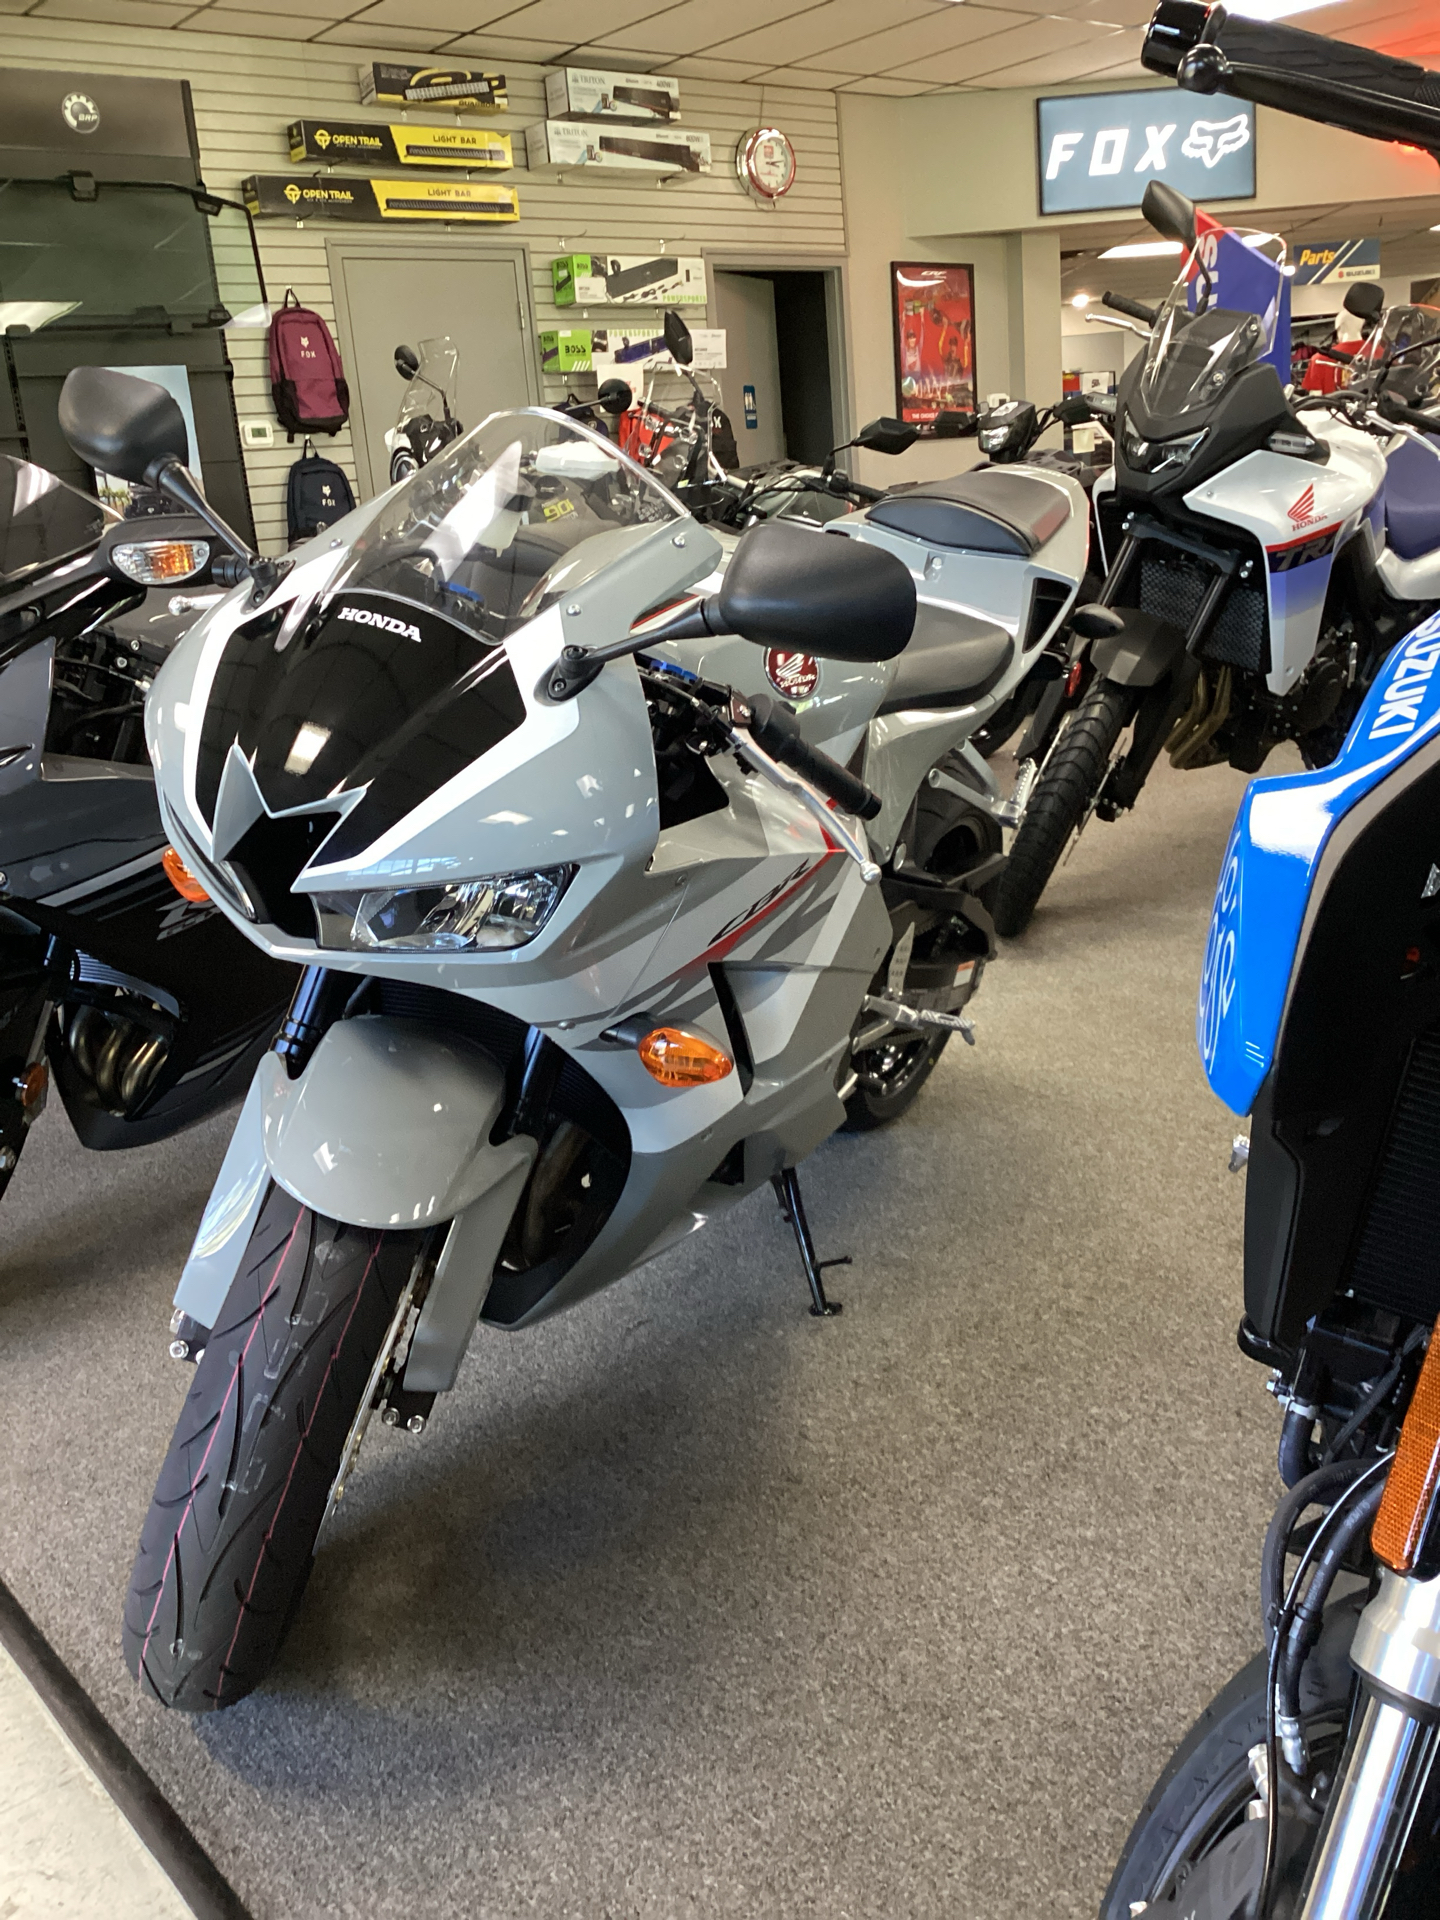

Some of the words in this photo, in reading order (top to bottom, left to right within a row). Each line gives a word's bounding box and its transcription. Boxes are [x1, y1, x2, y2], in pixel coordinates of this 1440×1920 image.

[580, 74, 606, 85] TRITON
[78, 113, 98, 122] BRP
[562, 127, 588, 138] TRITON
[332, 134, 357, 146] OPEN
[358, 136, 383, 147] TRAIL
[433, 134, 457, 145] LIGHT
[460, 136, 477, 145] BAR
[1045, 123, 1177, 180] FOX
[303, 188, 329, 199] OPEN
[329, 190, 354, 200] TRAIL
[427, 188, 452, 197] LIGHT
[455, 189, 471, 198] BAR
[1299, 248, 1336, 266] Parts
[1345, 269, 1376, 277] SUZUKI
[300, 350, 316, 359] FOX
[564, 344, 587, 354] BOSS
[321, 498, 336, 507] FOX
[543, 498, 575, 523] 901
[1291, 513, 1328, 532] HONDA
[337, 606, 422, 643] HONDA
[1368, 616, 1440, 740] SUZUKI
[707, 857, 812, 948] CBR
